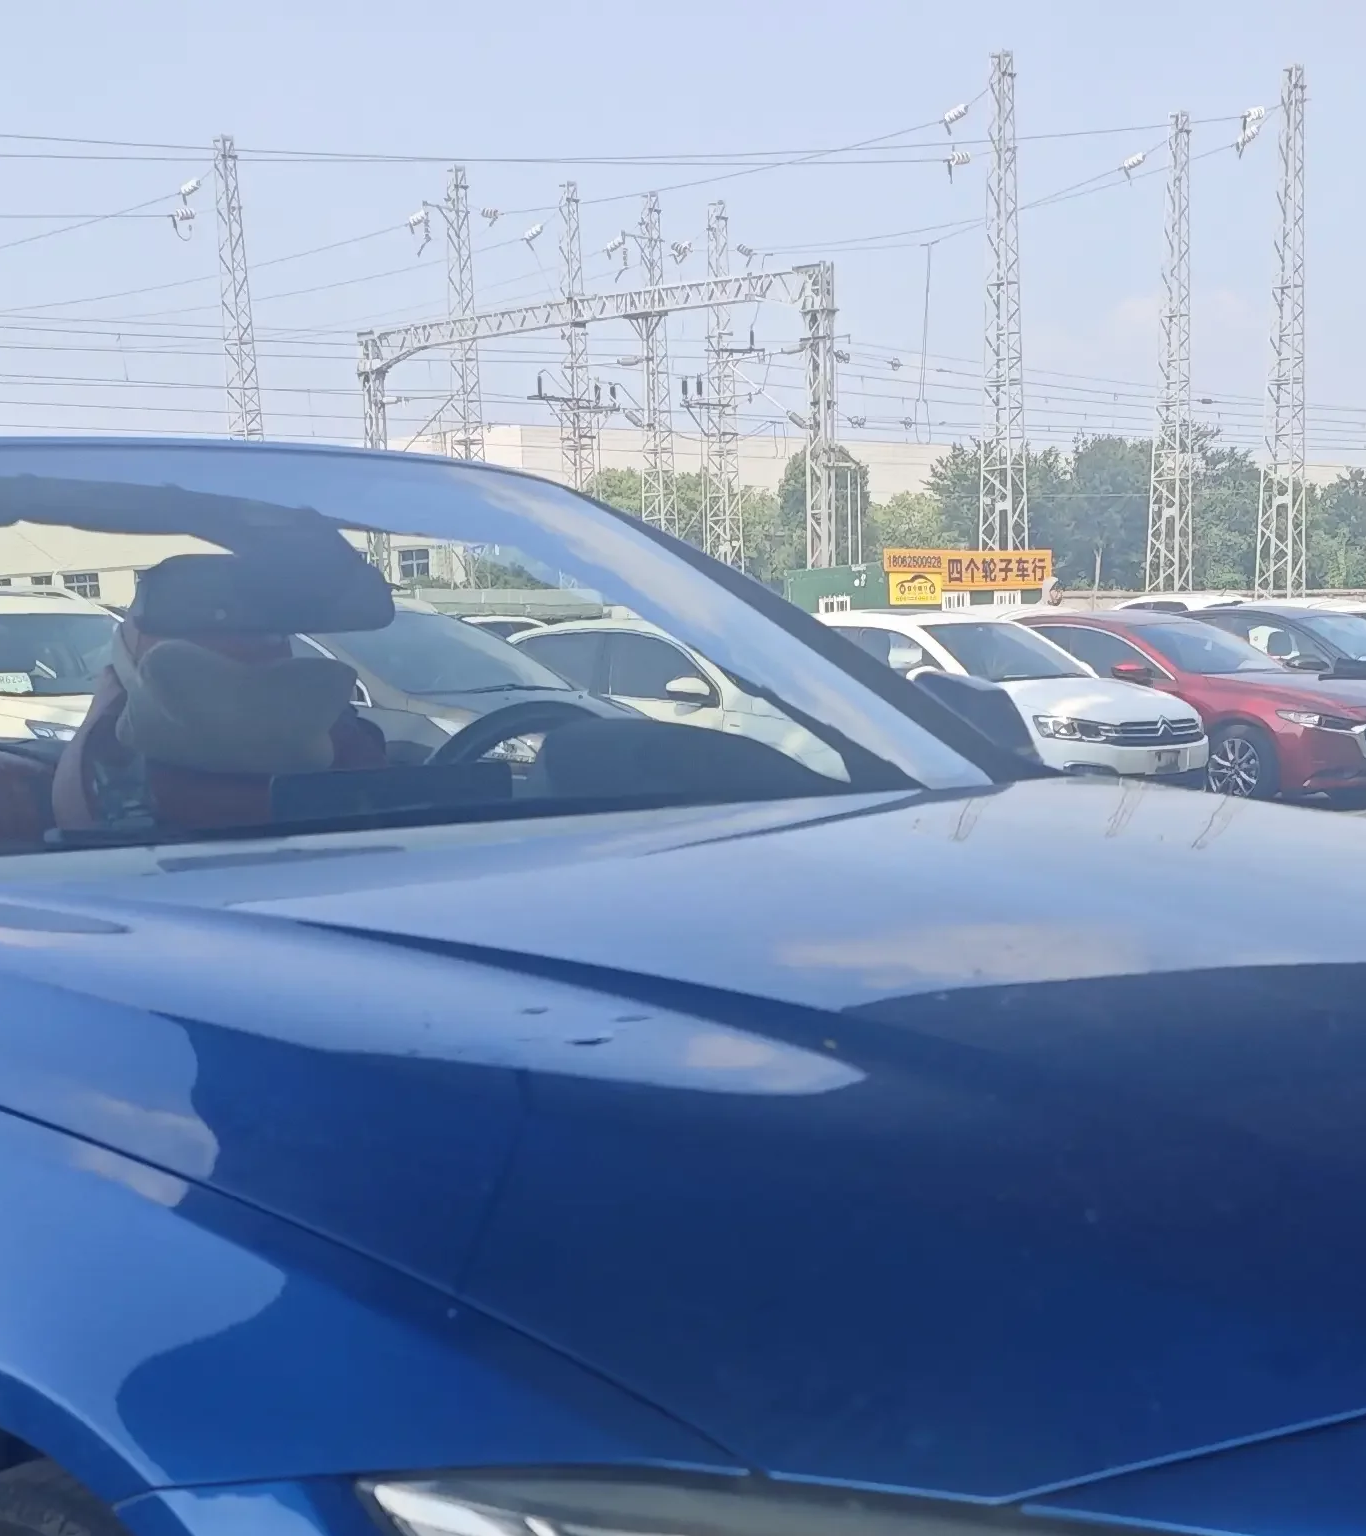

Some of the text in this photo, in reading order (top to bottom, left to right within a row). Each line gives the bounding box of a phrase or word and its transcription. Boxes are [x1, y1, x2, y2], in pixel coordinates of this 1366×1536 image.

[947, 557, 1047, 583] 四个轮子车行
